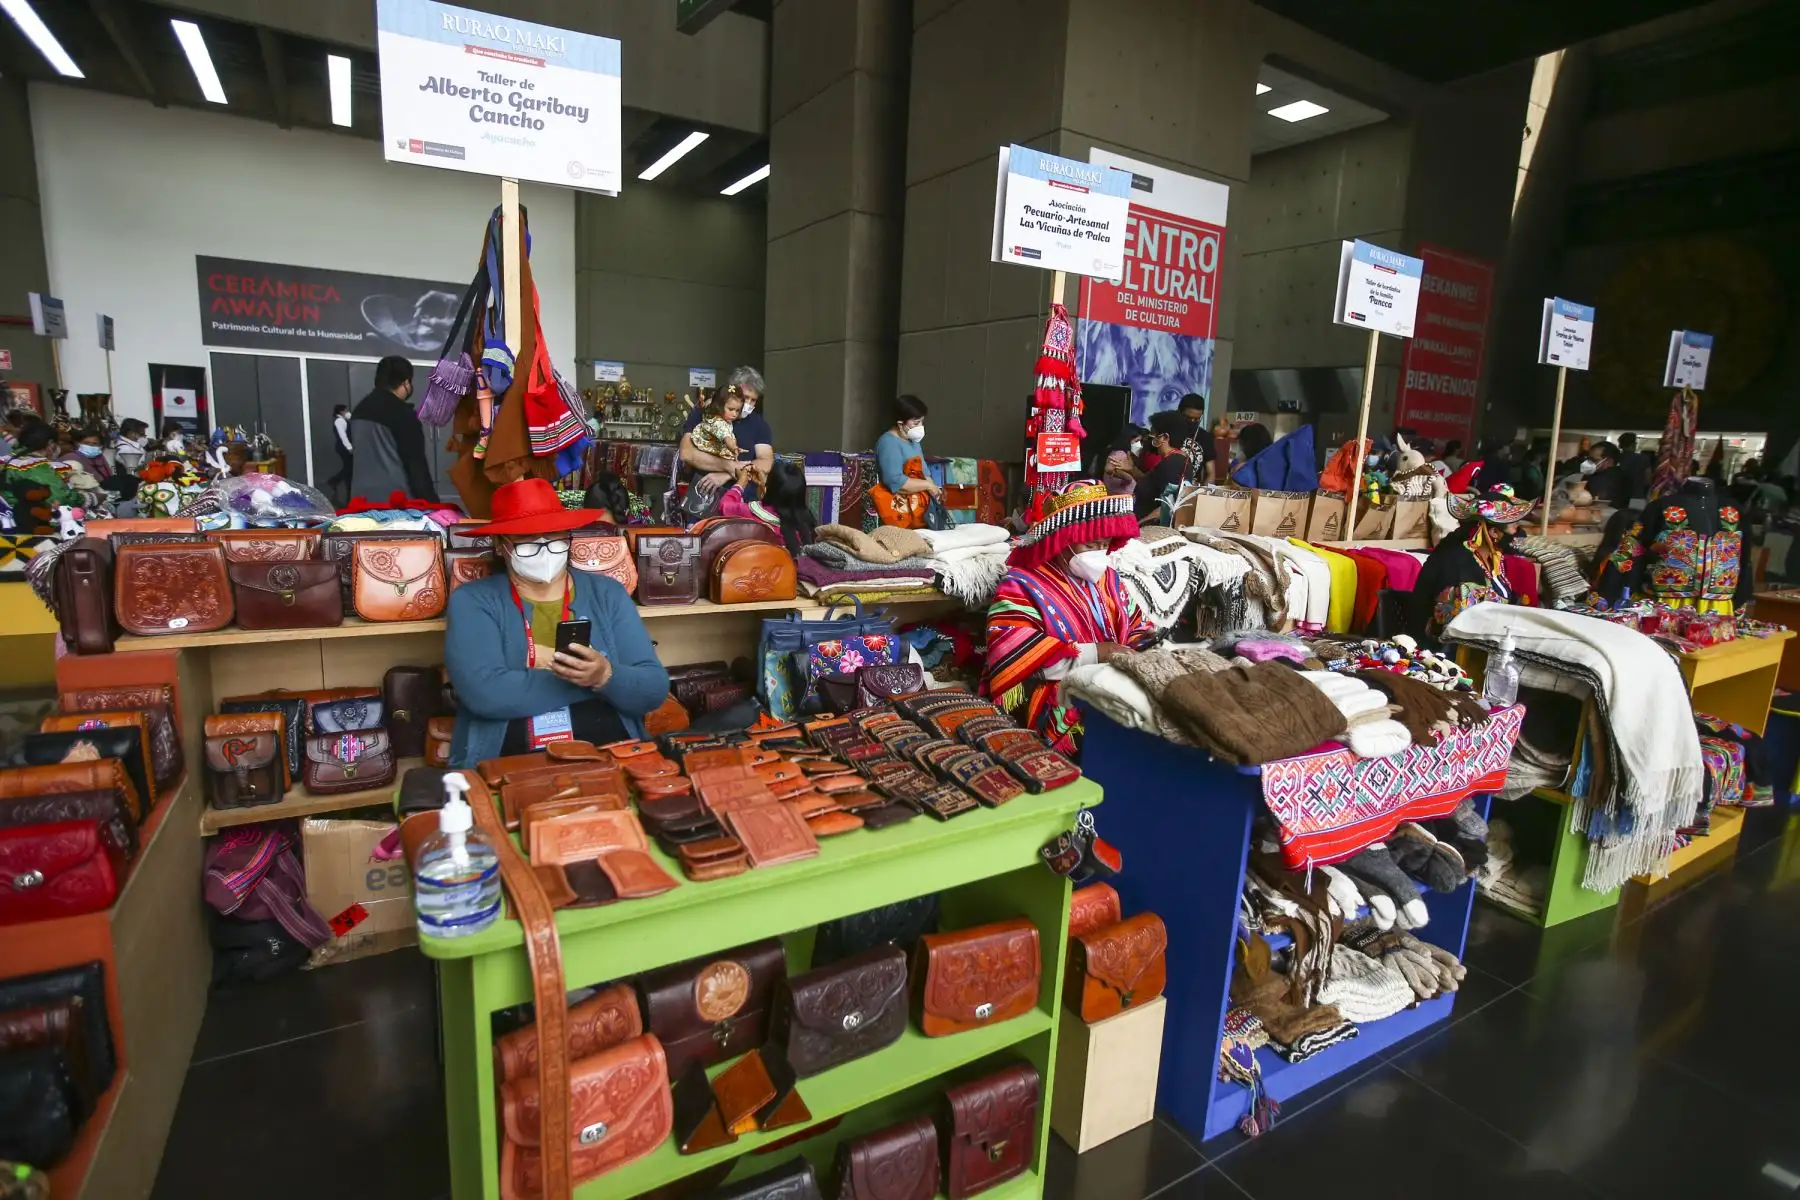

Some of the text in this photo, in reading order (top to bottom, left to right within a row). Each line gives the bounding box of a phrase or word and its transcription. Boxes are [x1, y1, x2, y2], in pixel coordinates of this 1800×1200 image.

[440, 13, 511, 43] RURAQ
[515, 29, 566, 52] MAKI
[477, 70, 535, 91] Taller de
[419, 75, 589, 123] Alberto Garibay
[469, 104, 545, 131] Cancho
[1039, 158, 1074, 177] RURAQ
[1075, 167, 1102, 184] MAKI
[1023, 204, 1110, 231] Pecuario-Artesanal
[1048, 199, 1087, 214] Asociación
[1019, 217, 1111, 243] Las Vicuñas de Palca
[1124, 217, 1219, 273] ENTRO
[1092, 260, 1213, 304] LTURAL
[1117, 291, 1188, 315] DEL MINISTERIO
[212, 321, 363, 341] Patrimonio Cultural de la Humanidad
[1125, 308, 1181, 328] DE CULTURA
[1406, 369, 1478, 398] BIENVENIDO
